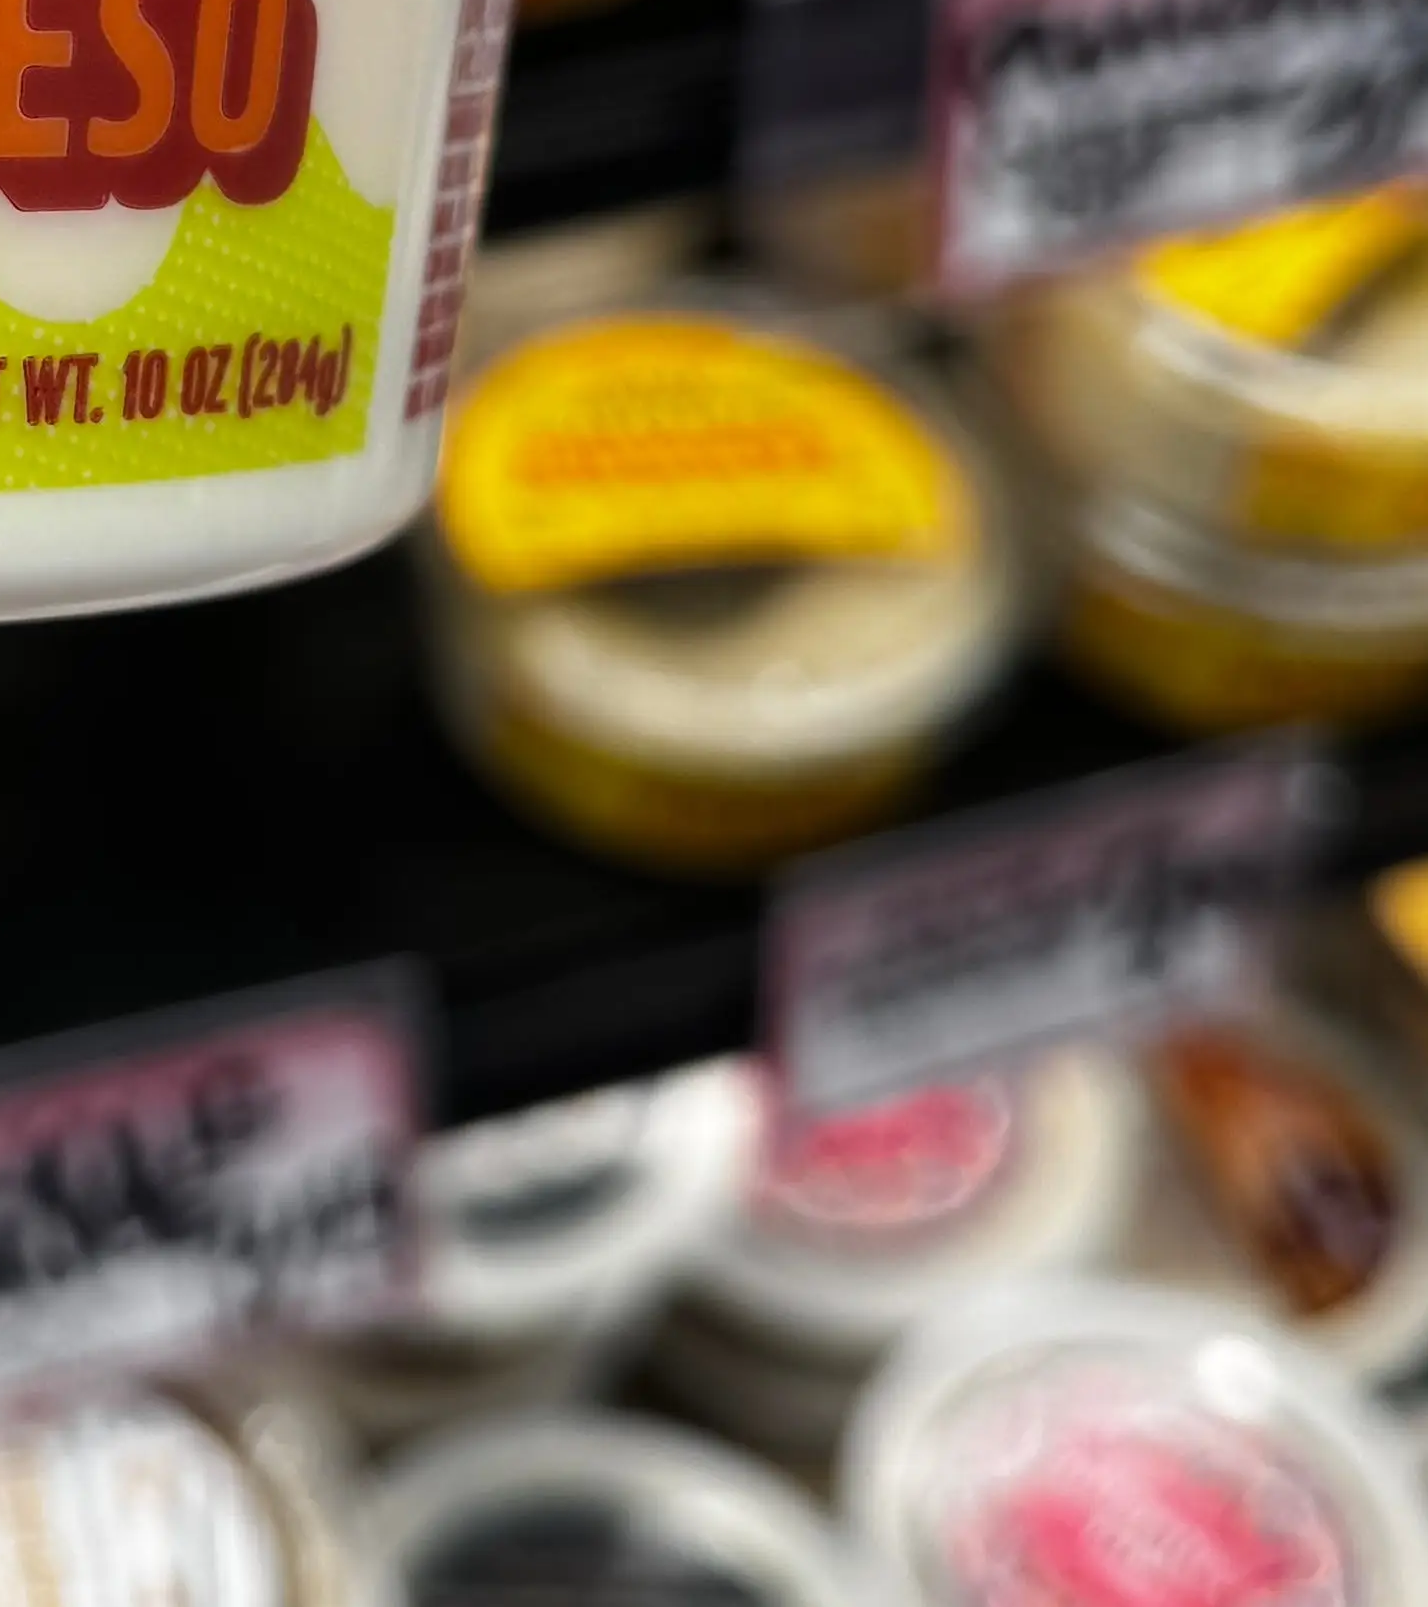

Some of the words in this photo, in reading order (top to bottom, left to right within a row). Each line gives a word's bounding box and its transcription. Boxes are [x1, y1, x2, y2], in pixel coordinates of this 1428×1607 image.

[20, 352, 104, 428] WT.
[120, 350, 164, 420] 10
[180, 344, 234, 416] OZ
[239, 324, 354, 418] (284g)
